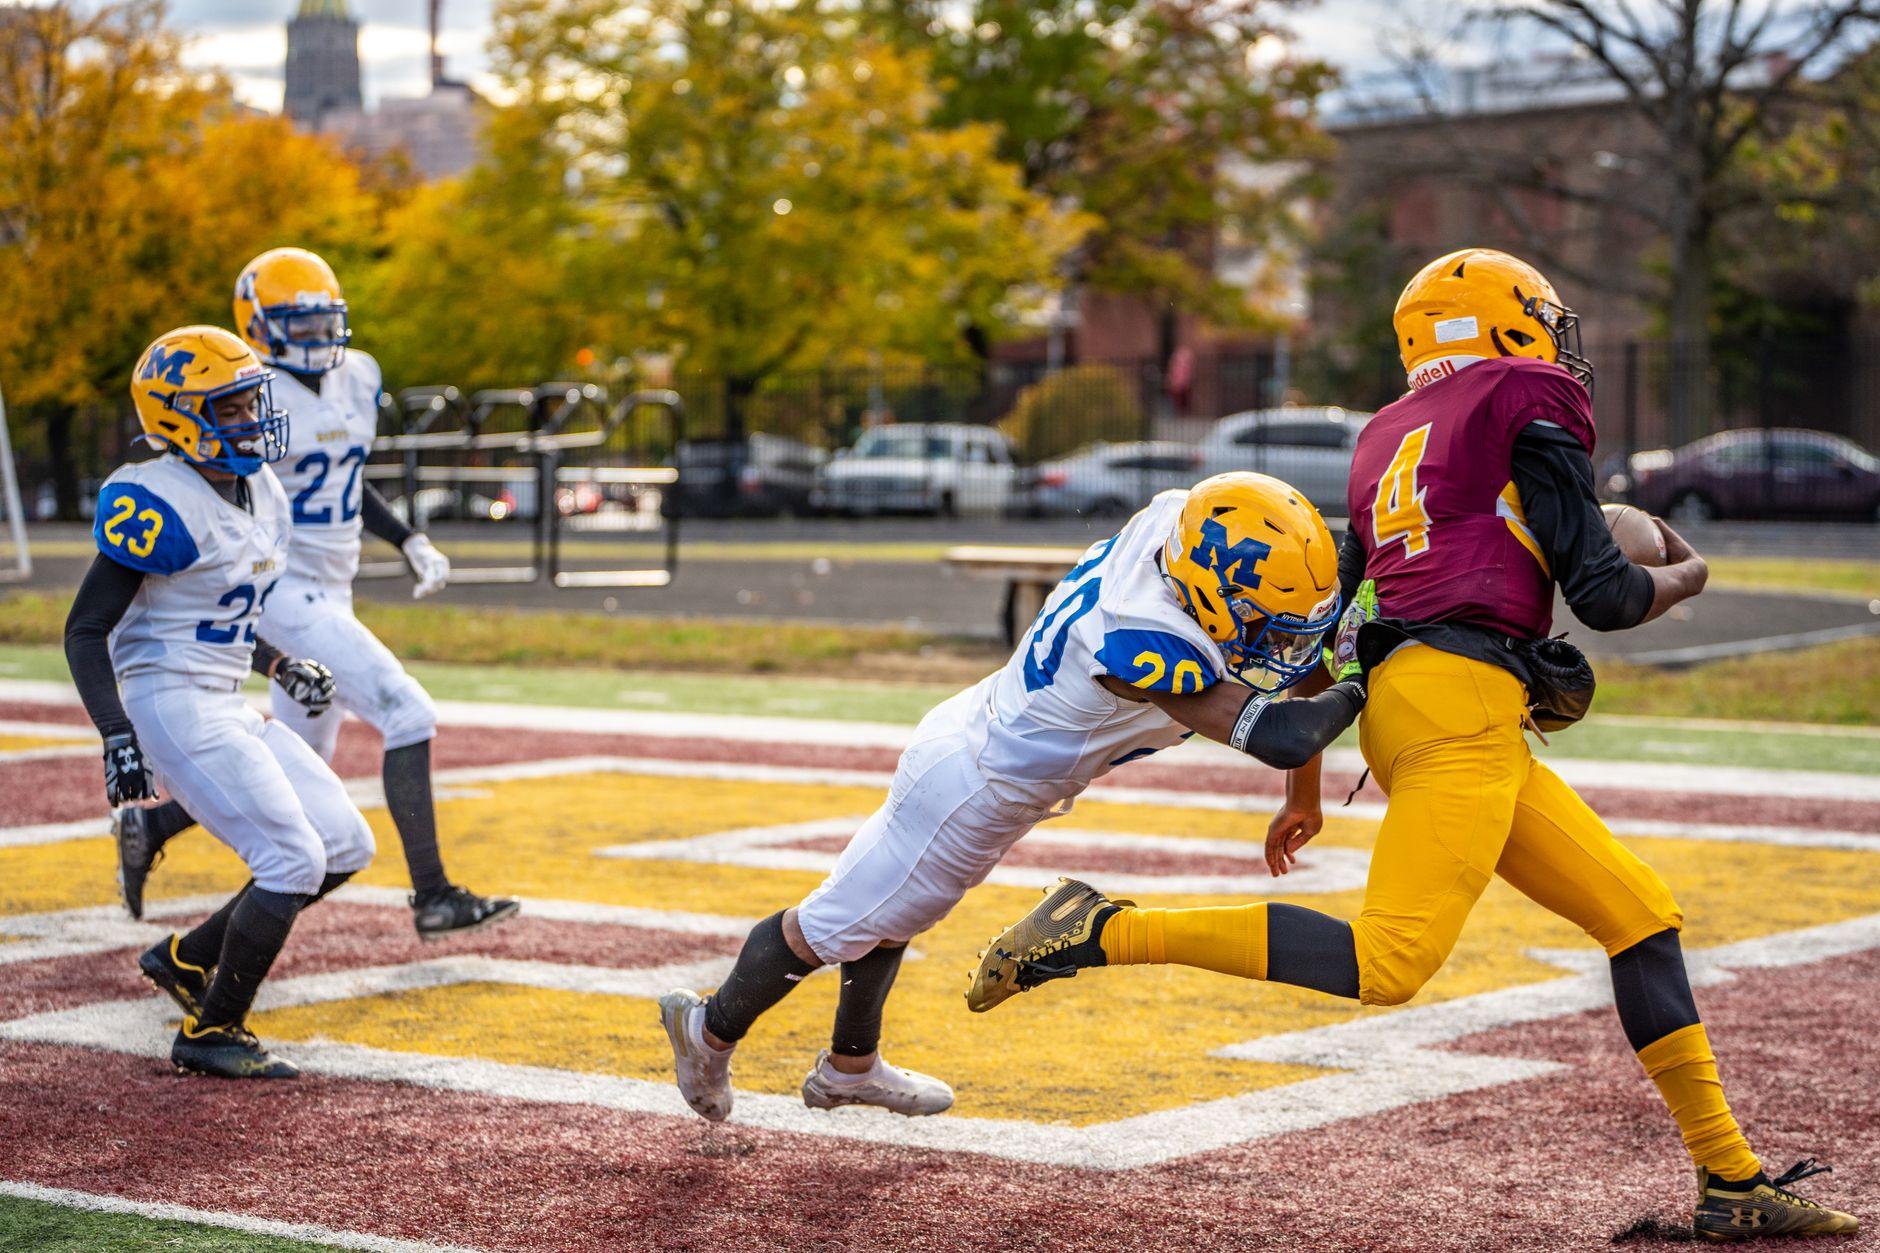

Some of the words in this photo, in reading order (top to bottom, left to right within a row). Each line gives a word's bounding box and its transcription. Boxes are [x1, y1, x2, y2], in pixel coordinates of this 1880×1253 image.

[142, 346, 196, 387] M
[293, 445, 366, 524] 22
[1372, 421, 1434, 560] 4
[104, 495, 164, 558] 23
[1189, 517, 1272, 591] M
[1130, 650, 1205, 695] 20
